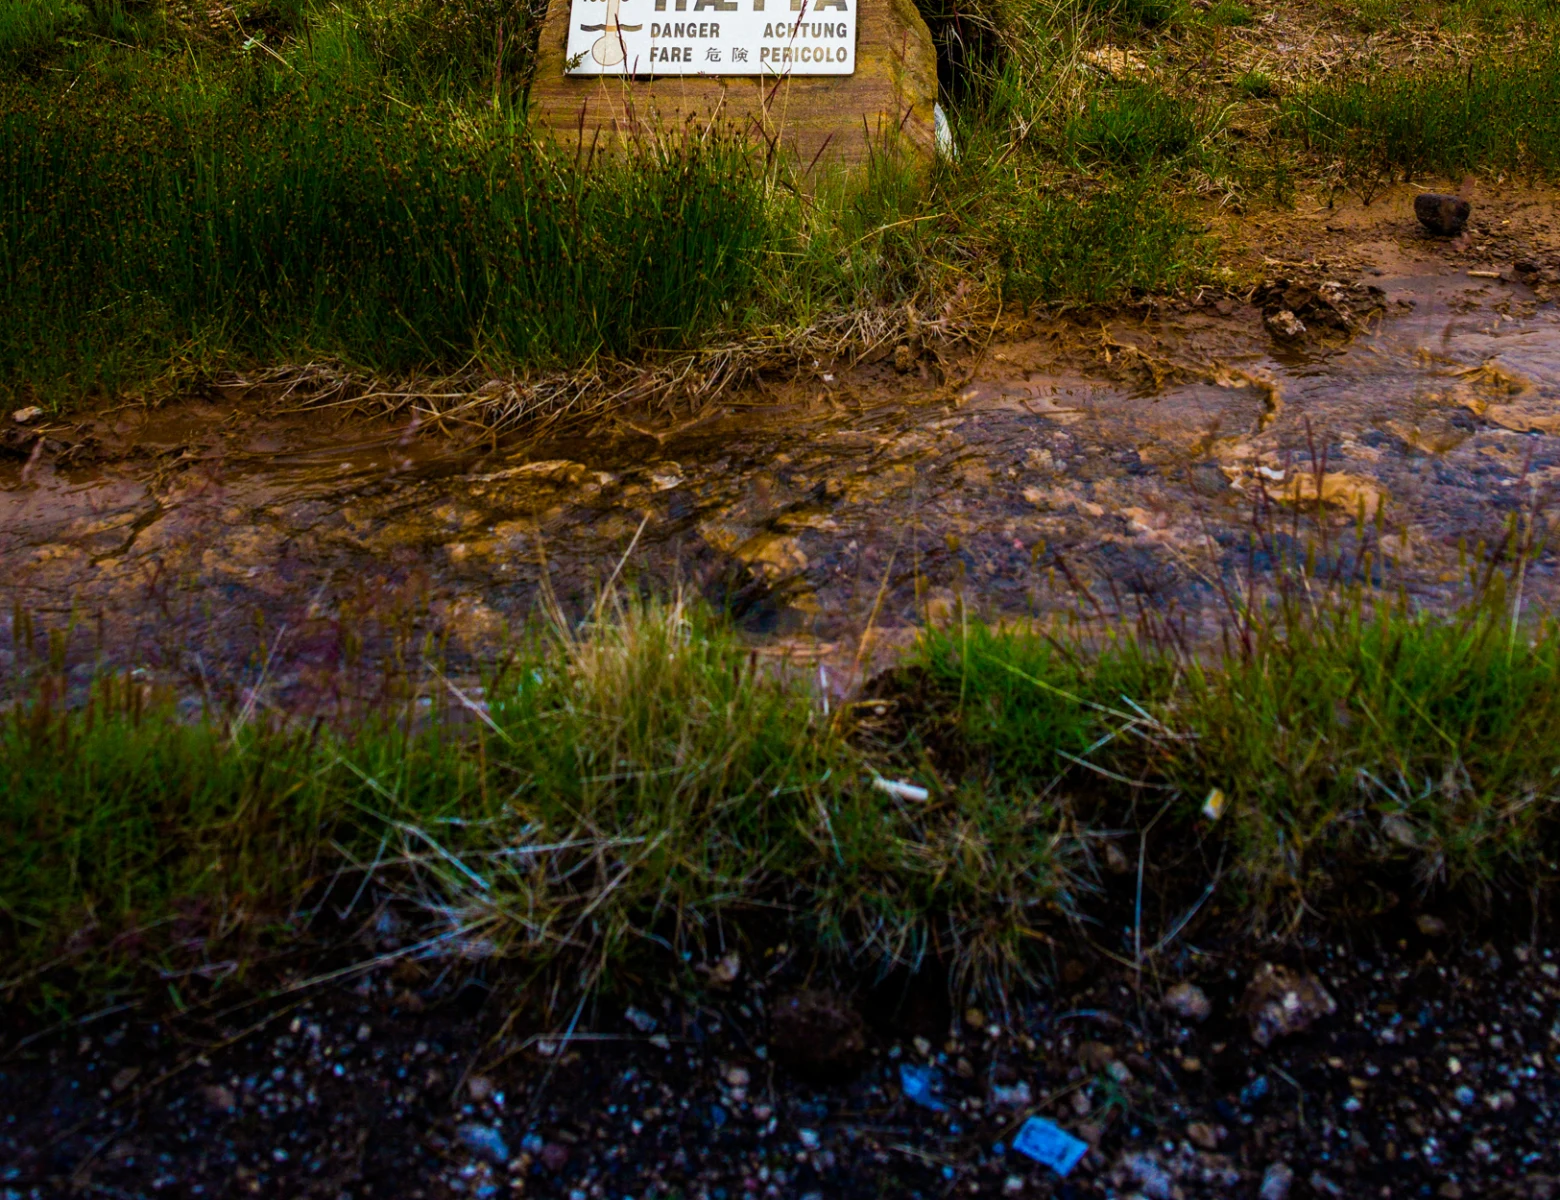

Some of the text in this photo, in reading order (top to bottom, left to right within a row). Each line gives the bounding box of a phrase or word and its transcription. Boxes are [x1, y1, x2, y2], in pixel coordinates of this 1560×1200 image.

[650, 22, 847, 38] DANGER ACHTUNG
[650, 46, 692, 62] FARE
[760, 46, 847, 62] PERICOLO
